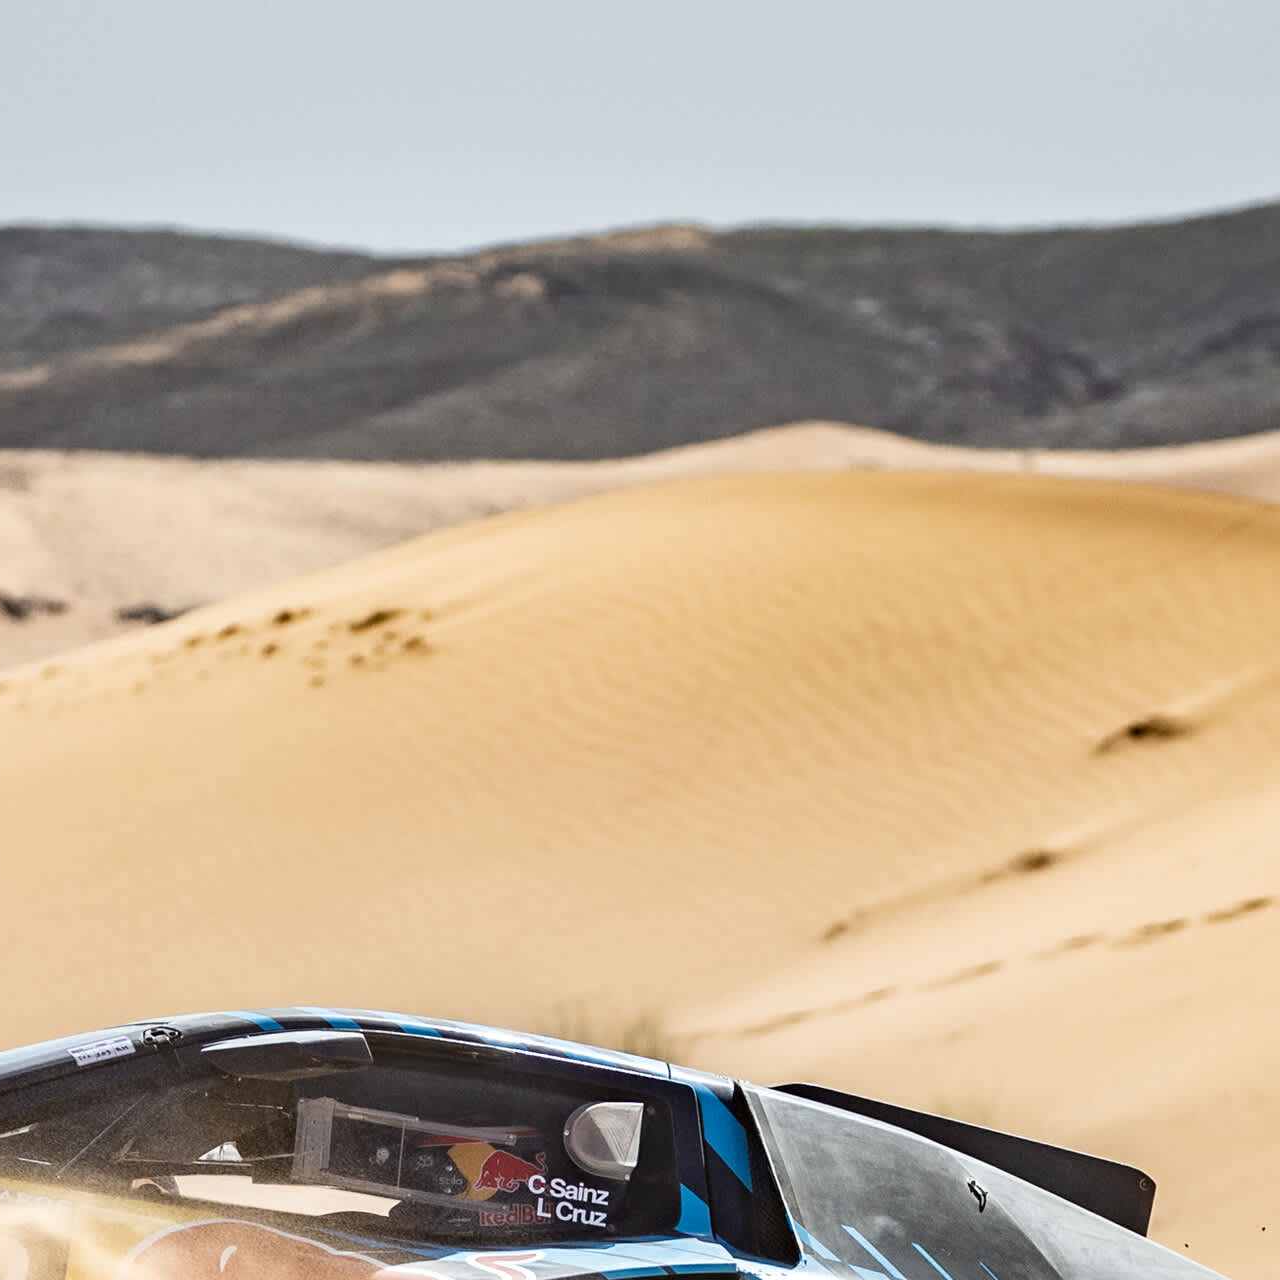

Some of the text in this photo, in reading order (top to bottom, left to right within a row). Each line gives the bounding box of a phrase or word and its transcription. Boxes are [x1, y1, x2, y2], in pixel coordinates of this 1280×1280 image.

[527, 1174, 610, 1206] C Sainz
[536, 1197, 608, 1228] L Cruz
